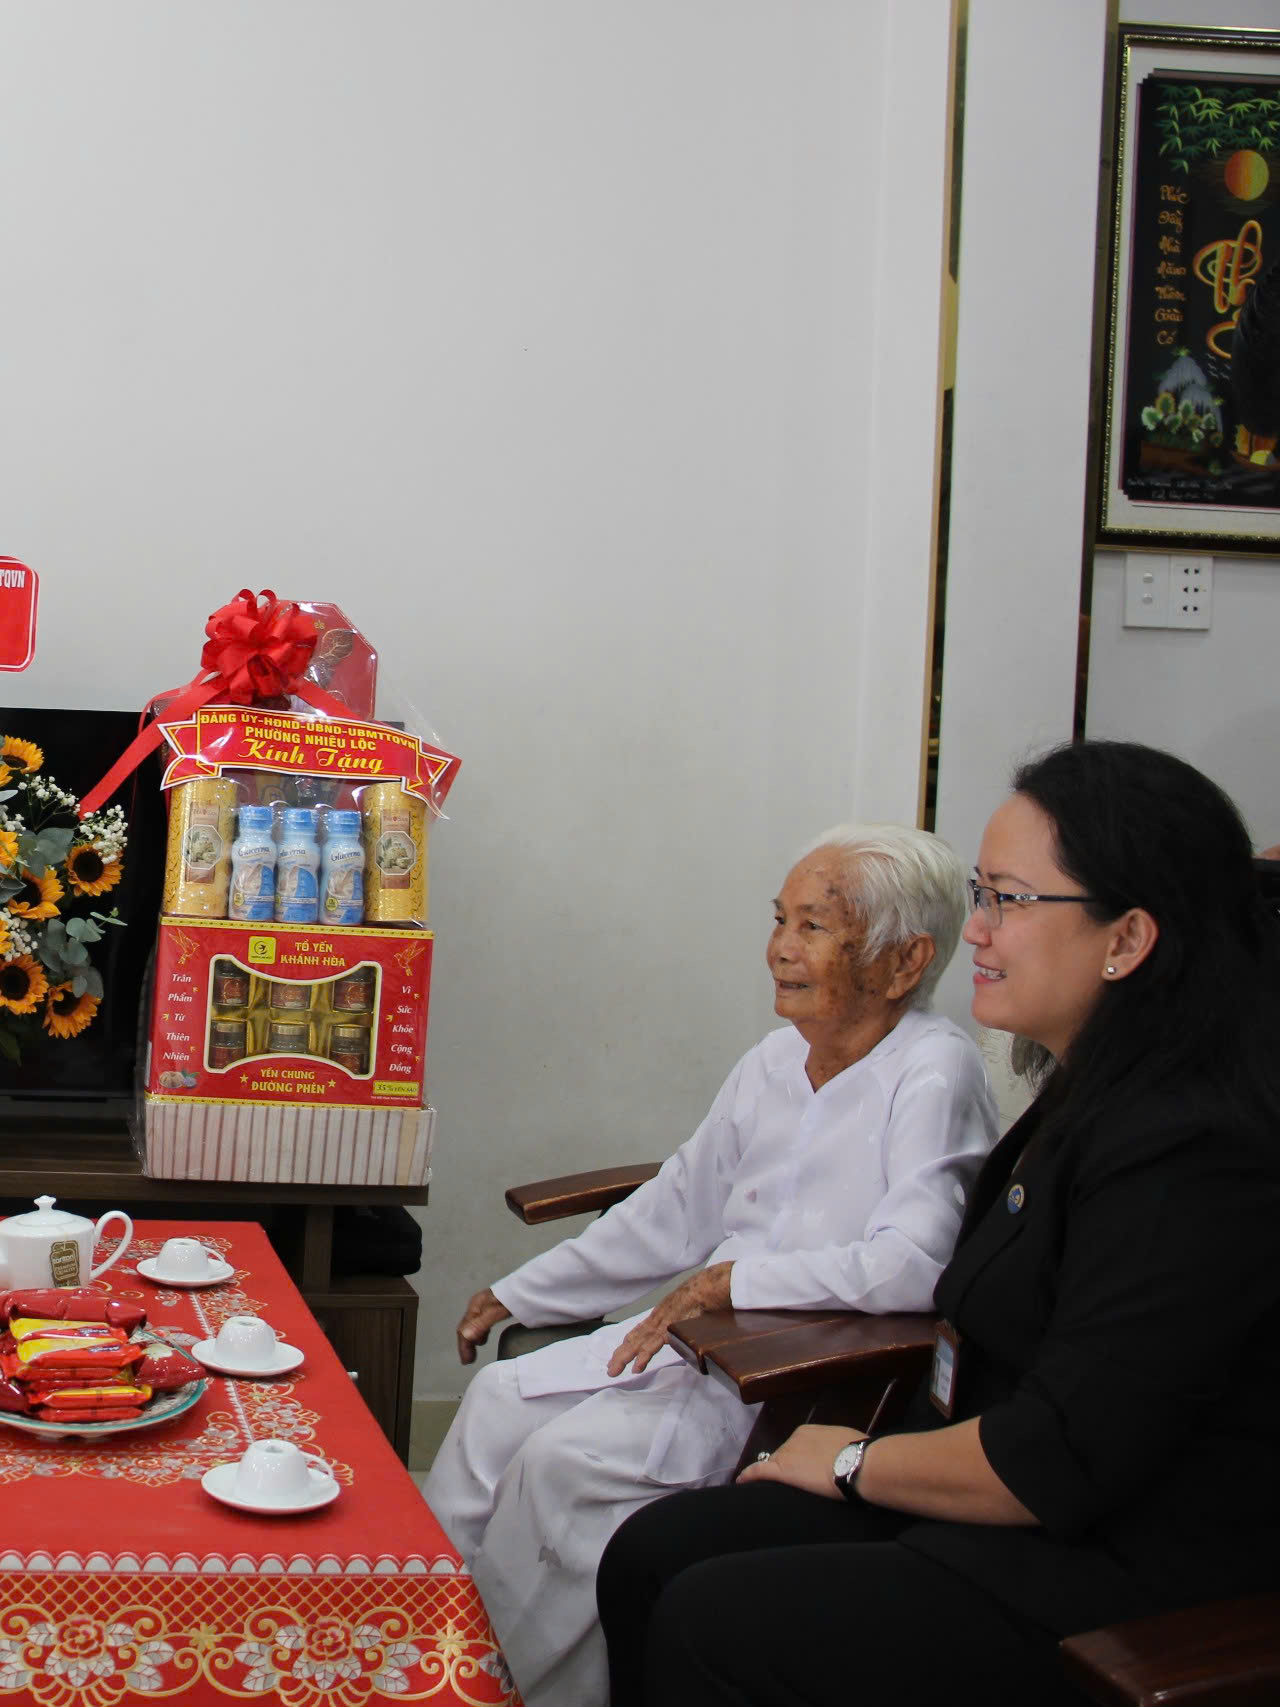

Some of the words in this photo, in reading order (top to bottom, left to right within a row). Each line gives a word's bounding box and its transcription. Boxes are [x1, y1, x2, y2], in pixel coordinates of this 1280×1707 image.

[200, 711, 237, 724] ĐẢNG
[245, 726, 301, 744] PHƯỜNG
[304, 734, 346, 749] NHIÊU
[350, 738, 377, 751] LỘC
[237, 738, 307, 765] Kính
[315, 747, 385, 774] Tặng
[330, 851, 361, 862] Glucerna
[295, 939, 310, 952] TỔ
[312, 941, 333, 953] YẾN
[280, 954, 319, 965] KHÁNH
[322, 956, 346, 967] HÒA
[167, 992, 193, 1002] Phẩm
[396, 1005, 413, 1014] Sức
[174, 1012, 186, 1022] Từ
[166, 1032, 190, 1041] Thiên
[390, 1043, 413, 1055] Cộng
[162, 1051, 190, 1061] Nhiên
[260, 1066, 279, 1078] YẾN
[389, 1062, 412, 1074] Đồng
[251, 1080, 293, 1092] ĐƯỜNG
[296, 1082, 326, 1094] PHÈN
